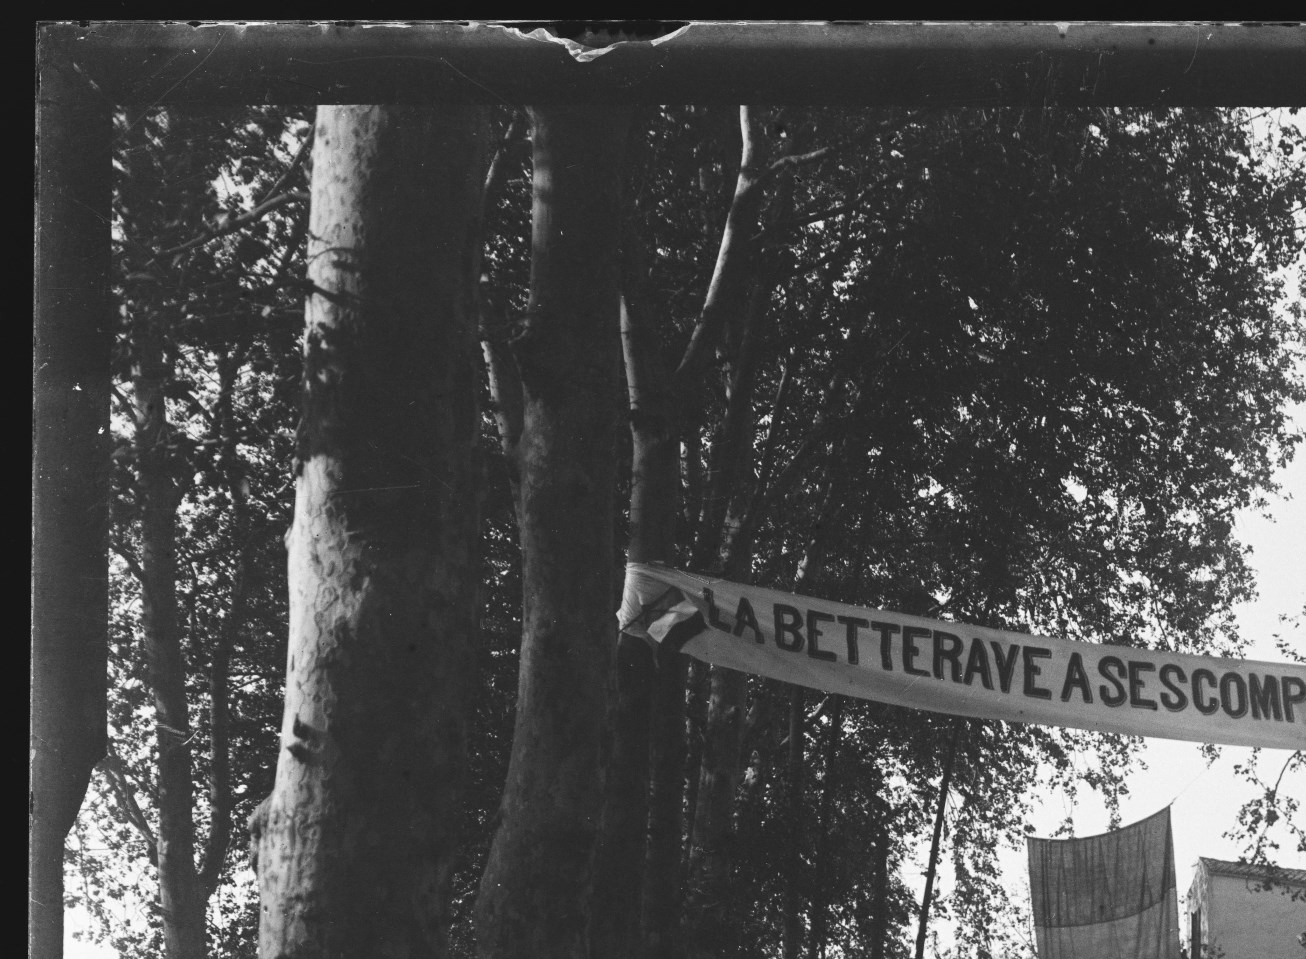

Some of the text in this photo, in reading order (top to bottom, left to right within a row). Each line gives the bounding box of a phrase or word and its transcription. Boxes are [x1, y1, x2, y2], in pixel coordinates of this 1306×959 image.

[702, 587, 765, 645] LA
[772, 602, 1053, 700] BETTERAVE
[1060, 652, 1094, 704] A
[1097, 655, 1189, 713] SES
